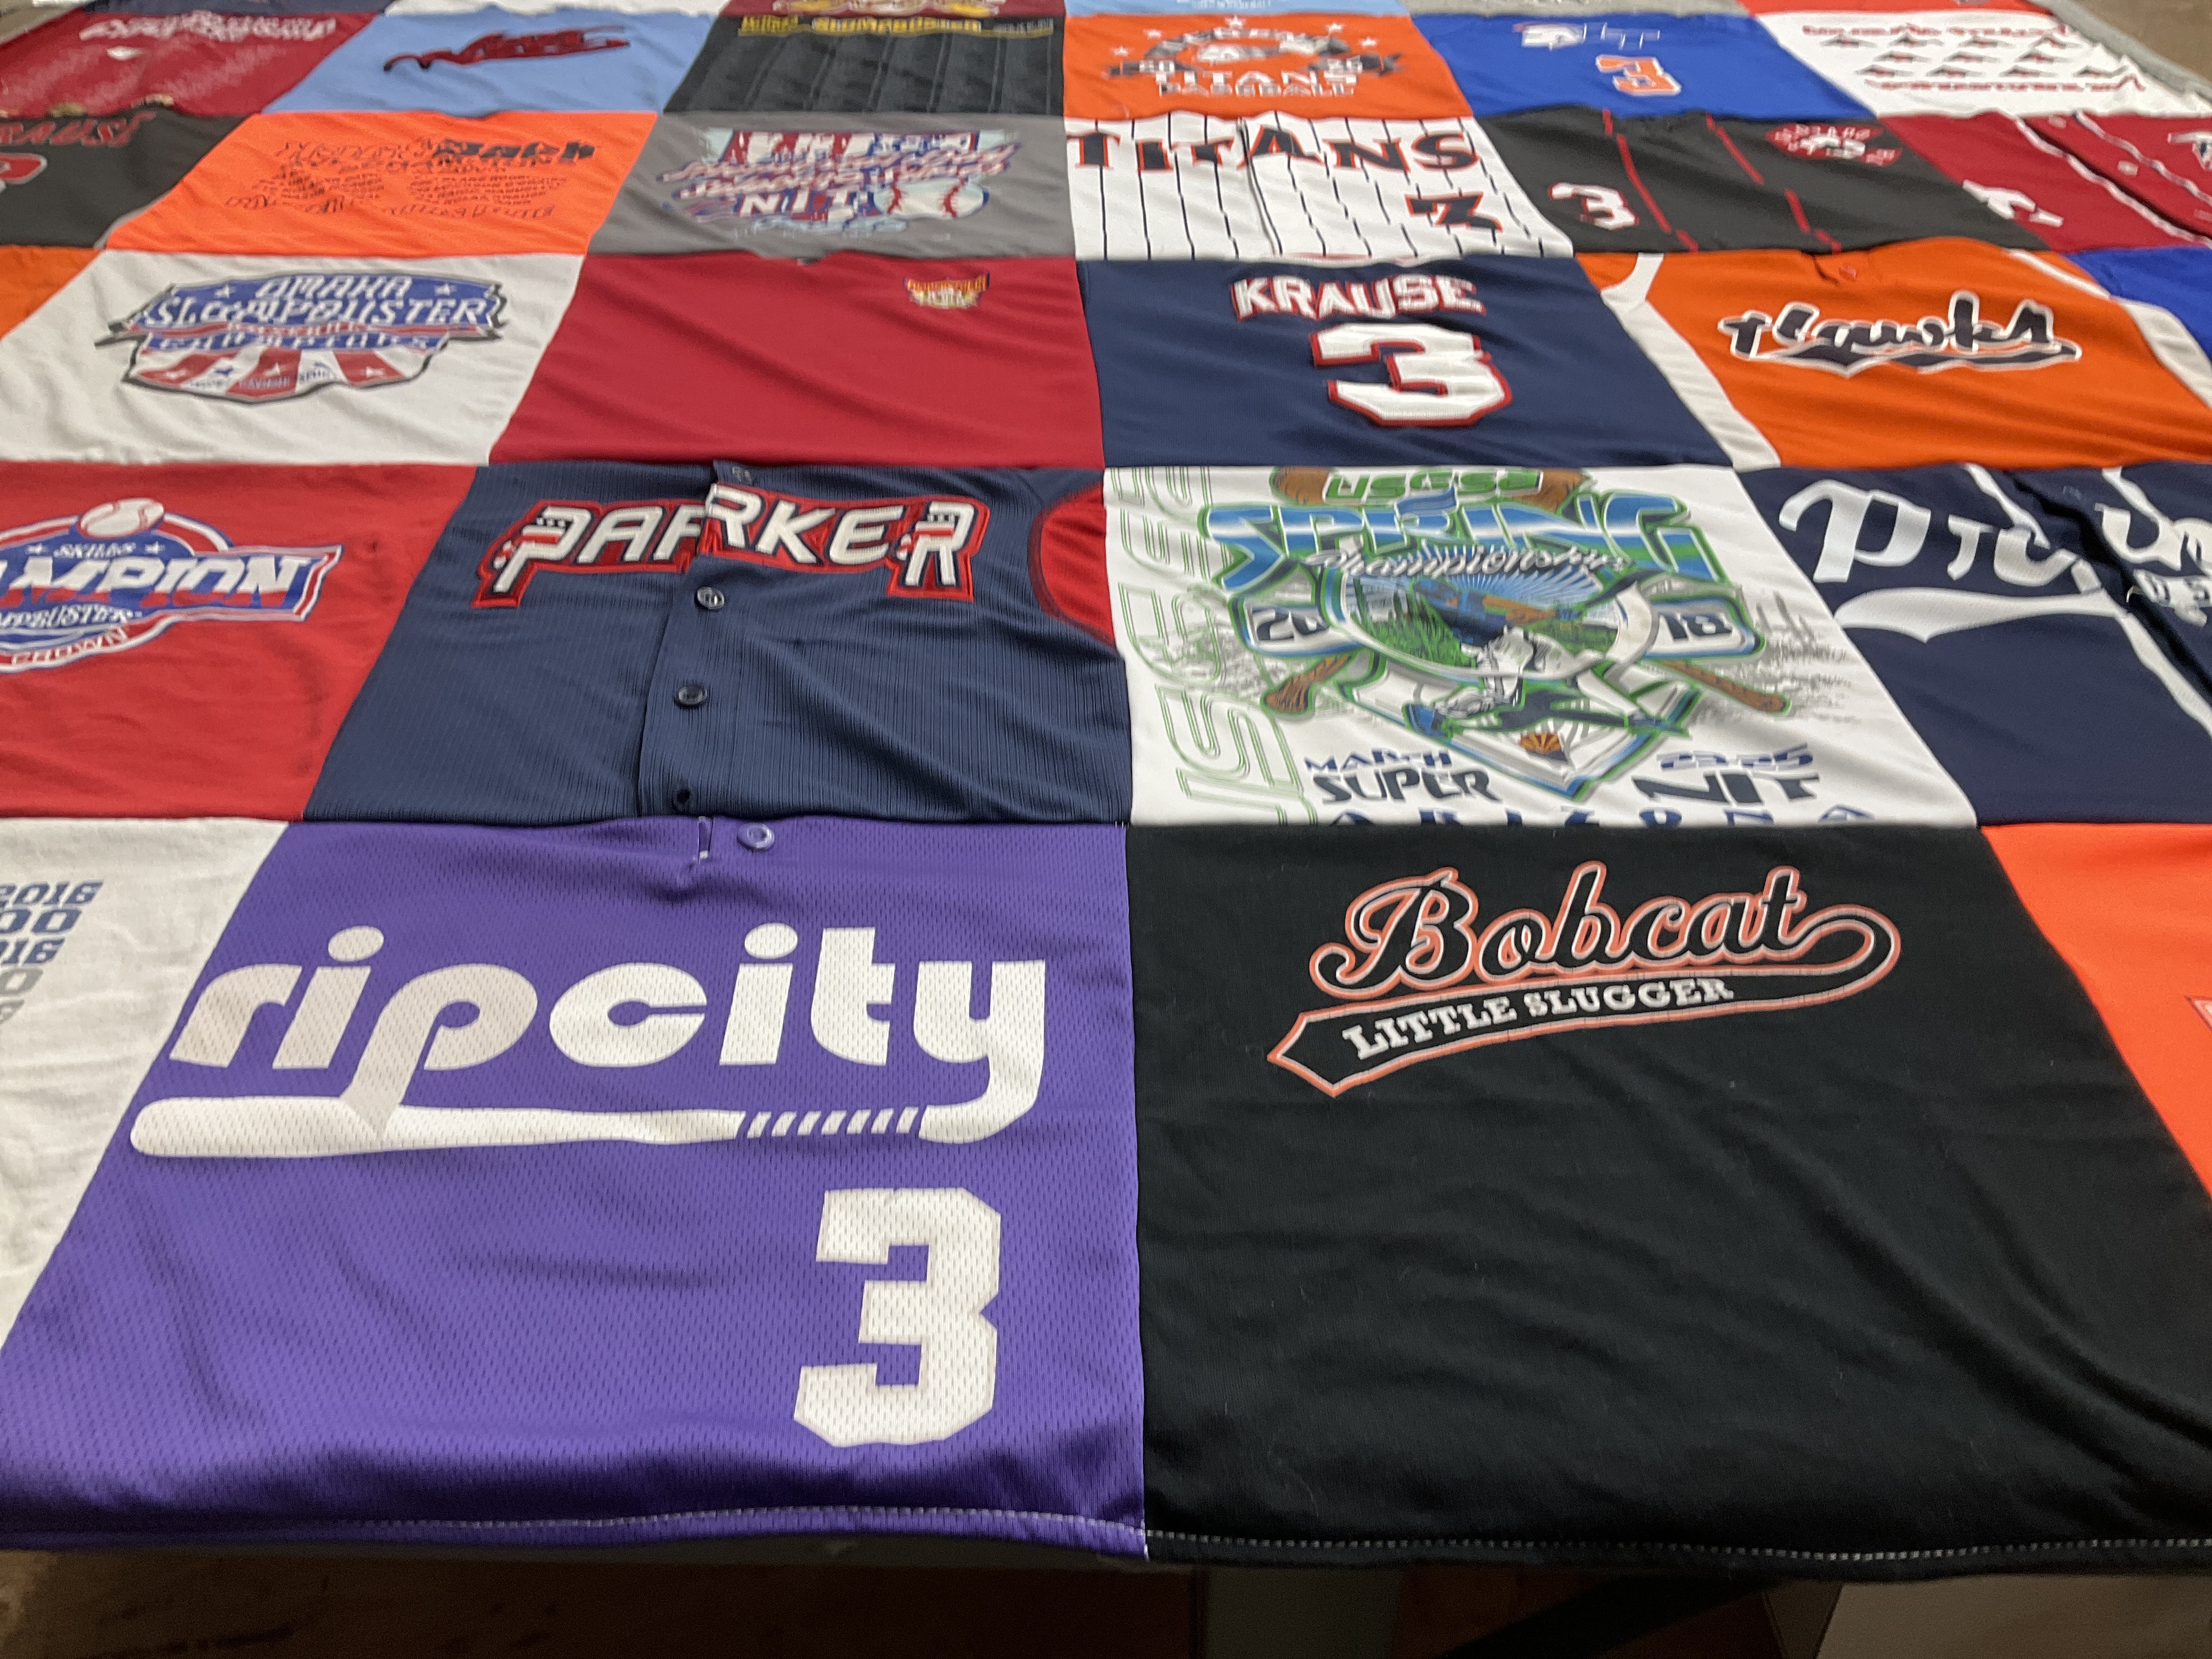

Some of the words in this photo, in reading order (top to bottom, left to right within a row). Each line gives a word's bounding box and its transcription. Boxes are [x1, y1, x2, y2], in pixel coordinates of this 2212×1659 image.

[1066, 125, 1480, 173] TITANS
[256, 274, 413, 298] OMAHA
[1231, 274, 1487, 323] KRAUSE
[1308, 322, 1513, 427] 3
[0, 555, 312, 607] MPION
[471, 482, 990, 608] PARKER
[1312, 767, 1502, 804] SUPER
[1308, 860, 1816, 1000] Bobcat
[170, 922, 1046, 1144] ripcity
[1342, 994, 1518, 1061] LITTLE
[1522, 977, 1734, 1019] SLUGGER
[793, 1186, 1001, 1447] 3
